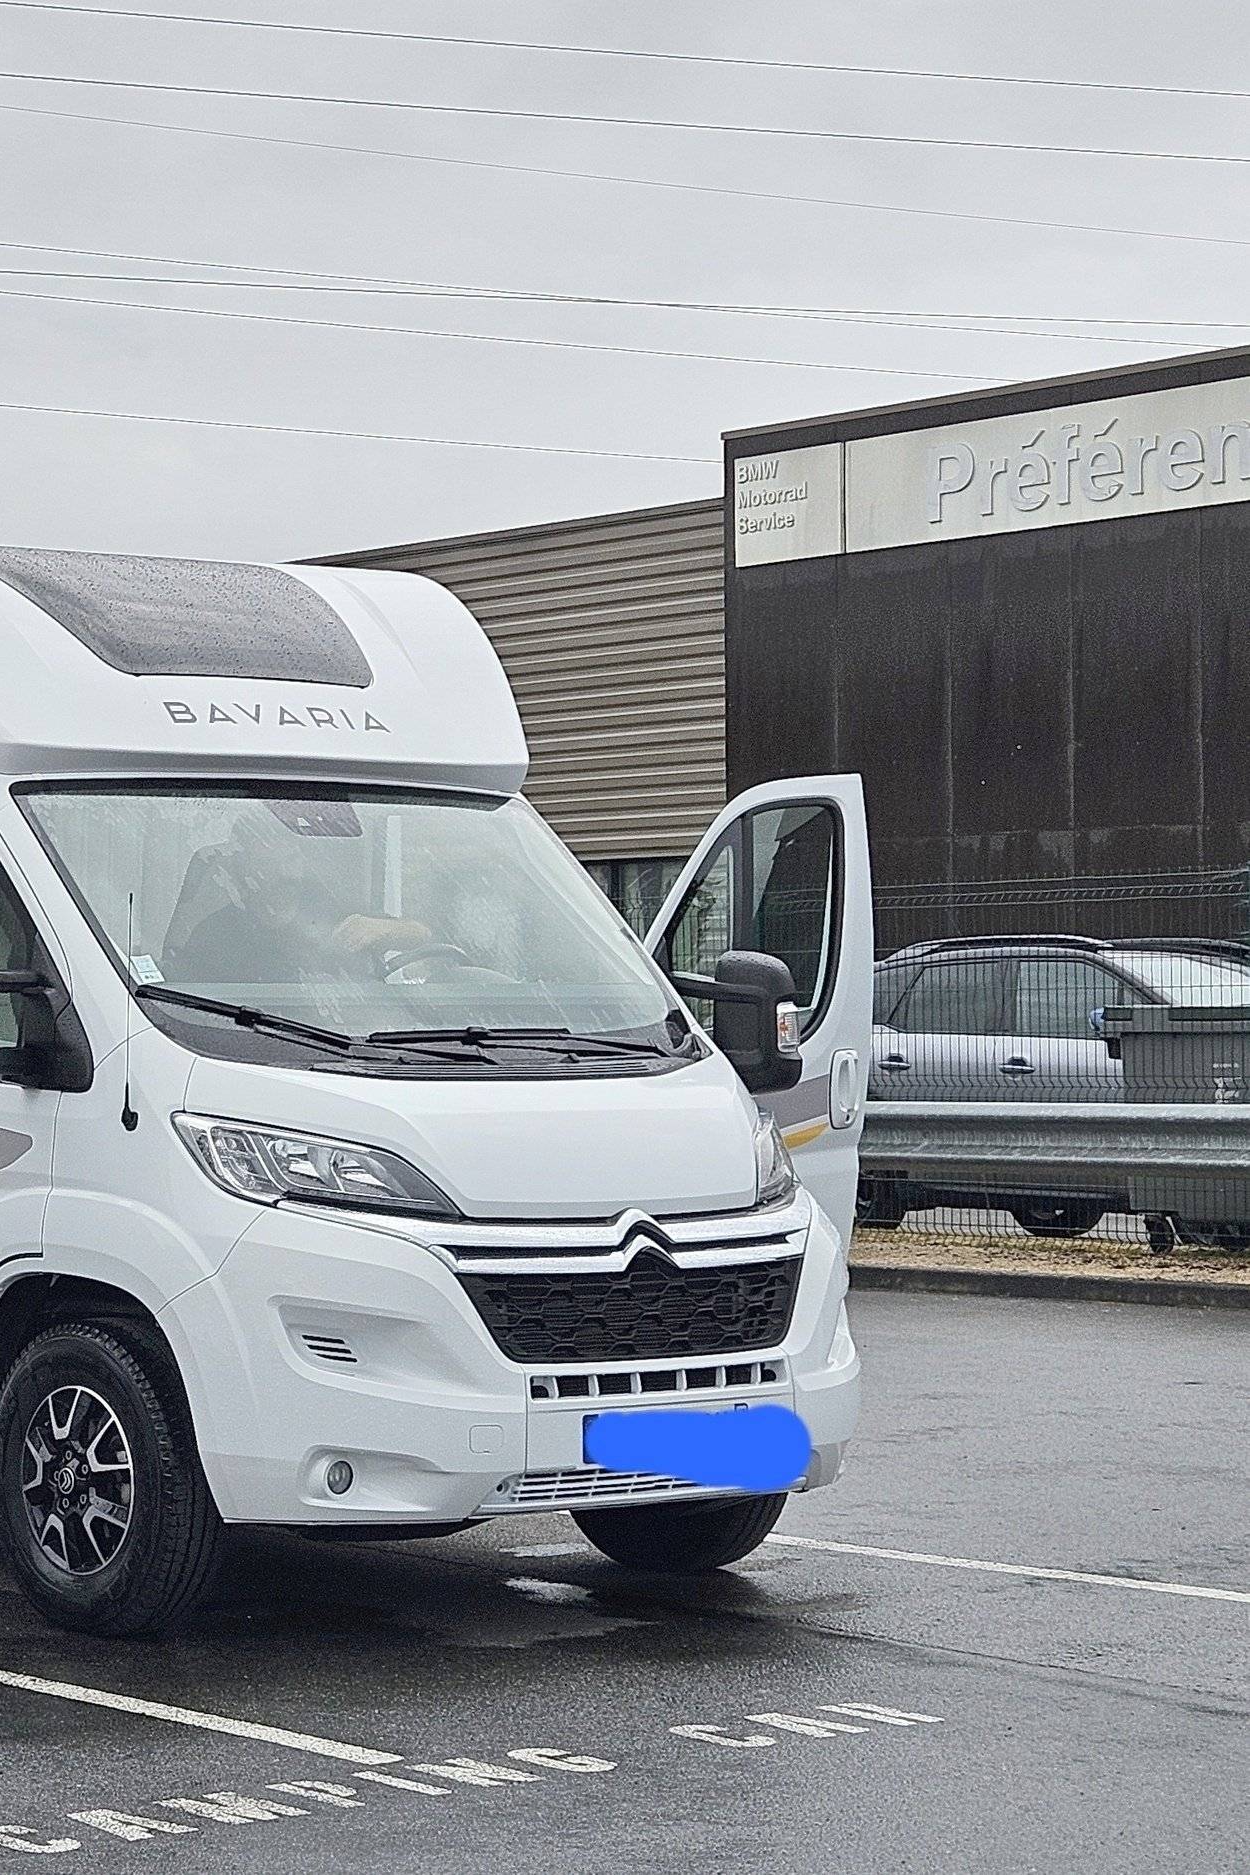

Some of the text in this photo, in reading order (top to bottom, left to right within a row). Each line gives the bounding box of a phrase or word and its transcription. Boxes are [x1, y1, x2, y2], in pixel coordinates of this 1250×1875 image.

[737, 460, 780, 484] BMW
[737, 481, 808, 509] Motorrad
[738, 511, 795, 535] Service
[162, 701, 392, 733] BAVARIA
[668, 1701, 946, 1749] CAR
